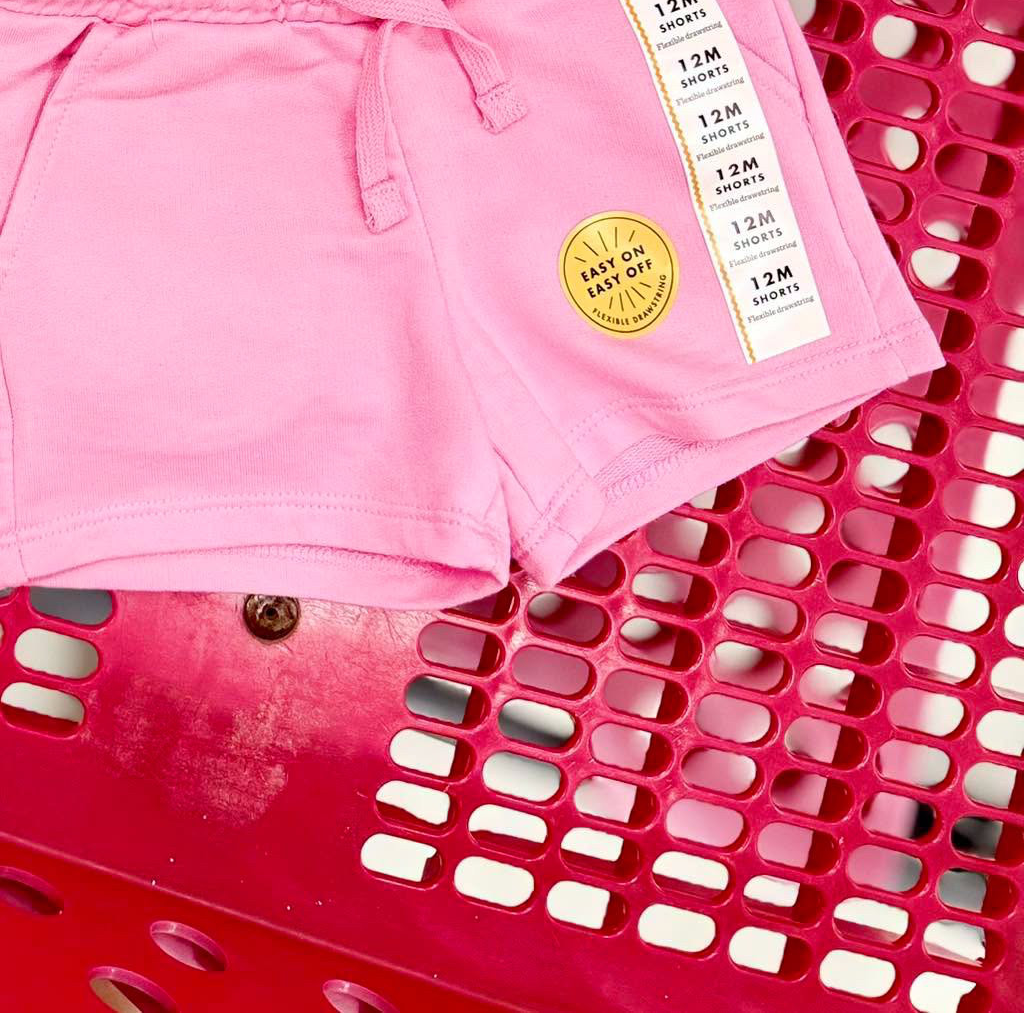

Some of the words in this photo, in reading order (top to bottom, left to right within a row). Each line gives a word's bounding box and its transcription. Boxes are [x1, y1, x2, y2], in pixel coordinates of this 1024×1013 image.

[659, 9, 707, 33] SHORTS
[656, 34, 685, 51] Flexible
[685, 20, 723, 40] drawstring
[678, 46, 722, 72] 12M
[680, 64, 730, 88] SHORTS
[676, 90, 705, 107] Flexible
[705, 76, 745, 96] drawstring
[698, 102, 742, 128] 12M
[701, 120, 750, 144] SHORTS
[696, 145, 725, 162] Flexible
[725, 131, 765, 152] drawstring
[716, 157, 759, 181] 12M
[715, 173, 765, 195] SHORTS
[709, 195, 739, 212] Flexible
[739, 185, 780, 202] drawstring
[731, 210, 776, 235] 12M
[733, 228, 783, 251] SHORTS
[580, 257, 615, 283] EASY
[621, 244, 646, 262] ON
[729, 252, 758, 268] Flexible
[758, 240, 798, 259] drawstring
[586, 273, 621, 299] EASY
[626, 259, 653, 278] OFF
[750, 265, 794, 290] 12M
[592, 307, 630, 326] FLEXIBLE
[632, 274, 667, 324] DRAWSTRING
[752, 283, 800, 306] SHORTS
[747, 307, 777, 324] Flexible
[776, 295, 815, 315] drawstring
